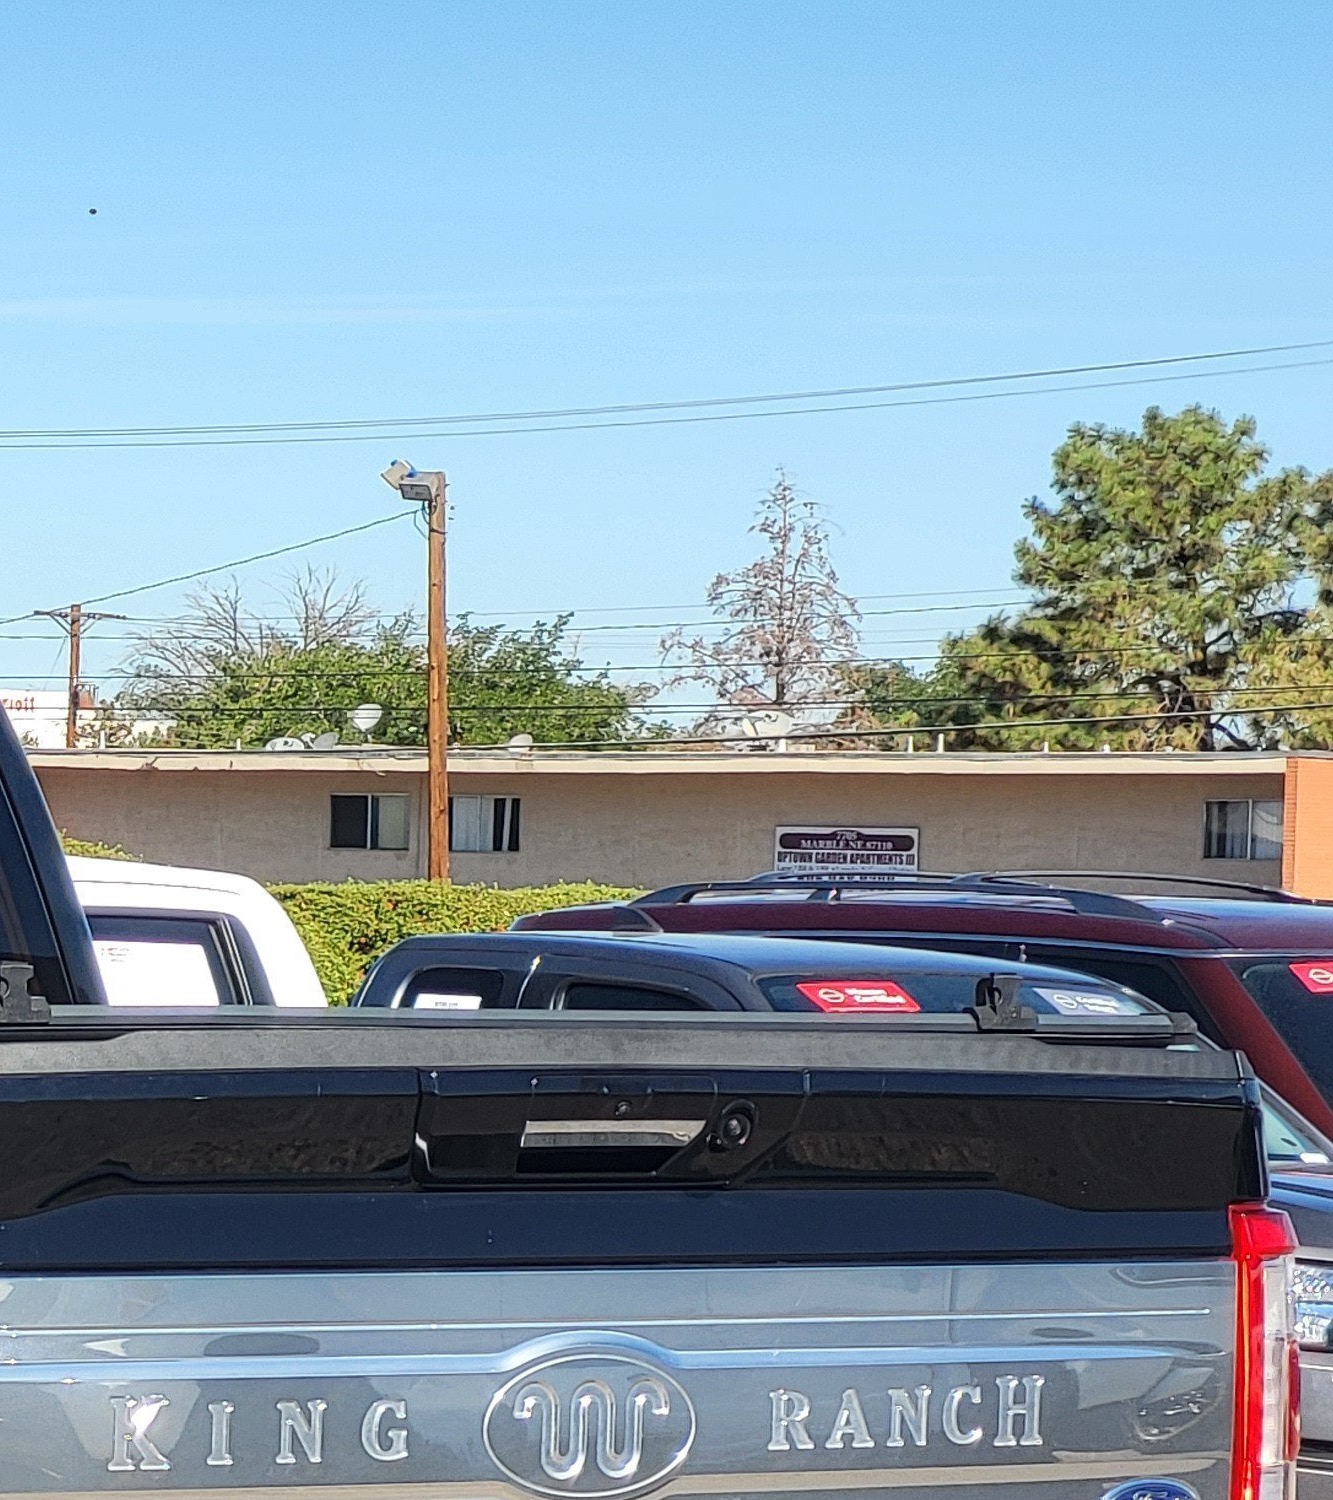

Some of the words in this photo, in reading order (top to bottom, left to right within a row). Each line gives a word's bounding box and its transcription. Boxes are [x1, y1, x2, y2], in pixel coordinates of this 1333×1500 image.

[801, 839, 845, 849] MARBLE
[777, 851, 813, 863] UPTOWN
[815, 852, 848, 864] GARDEN
[849, 853, 904, 865] APARTMENTS
[107, 1394, 410, 1472] KING
[767, 1374, 1046, 1451] RANCH
